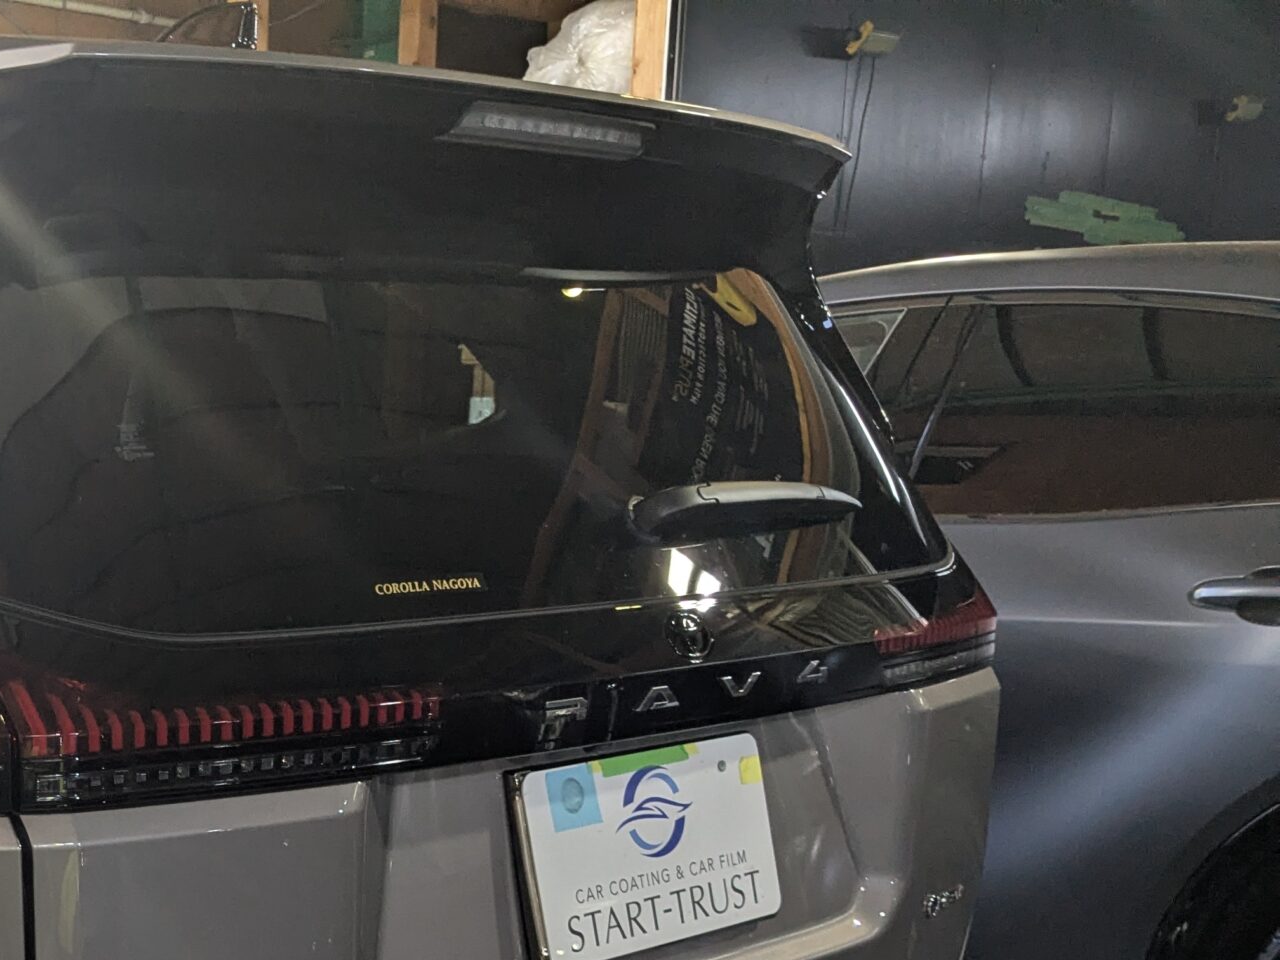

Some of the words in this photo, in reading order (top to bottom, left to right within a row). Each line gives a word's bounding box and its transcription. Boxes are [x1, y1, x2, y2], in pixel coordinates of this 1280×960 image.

[374, 580, 430, 595] COROLLA
[432, 577, 481, 591] NAGOYA
[575, 884, 604, 904] CAR
[608, 867, 671, 895] COATING
[675, 864, 685, 879] &
[688, 857, 716, 876] CAR
[719, 850, 747, 869] FILM
[567, 869, 760, 953] START-TRUST
